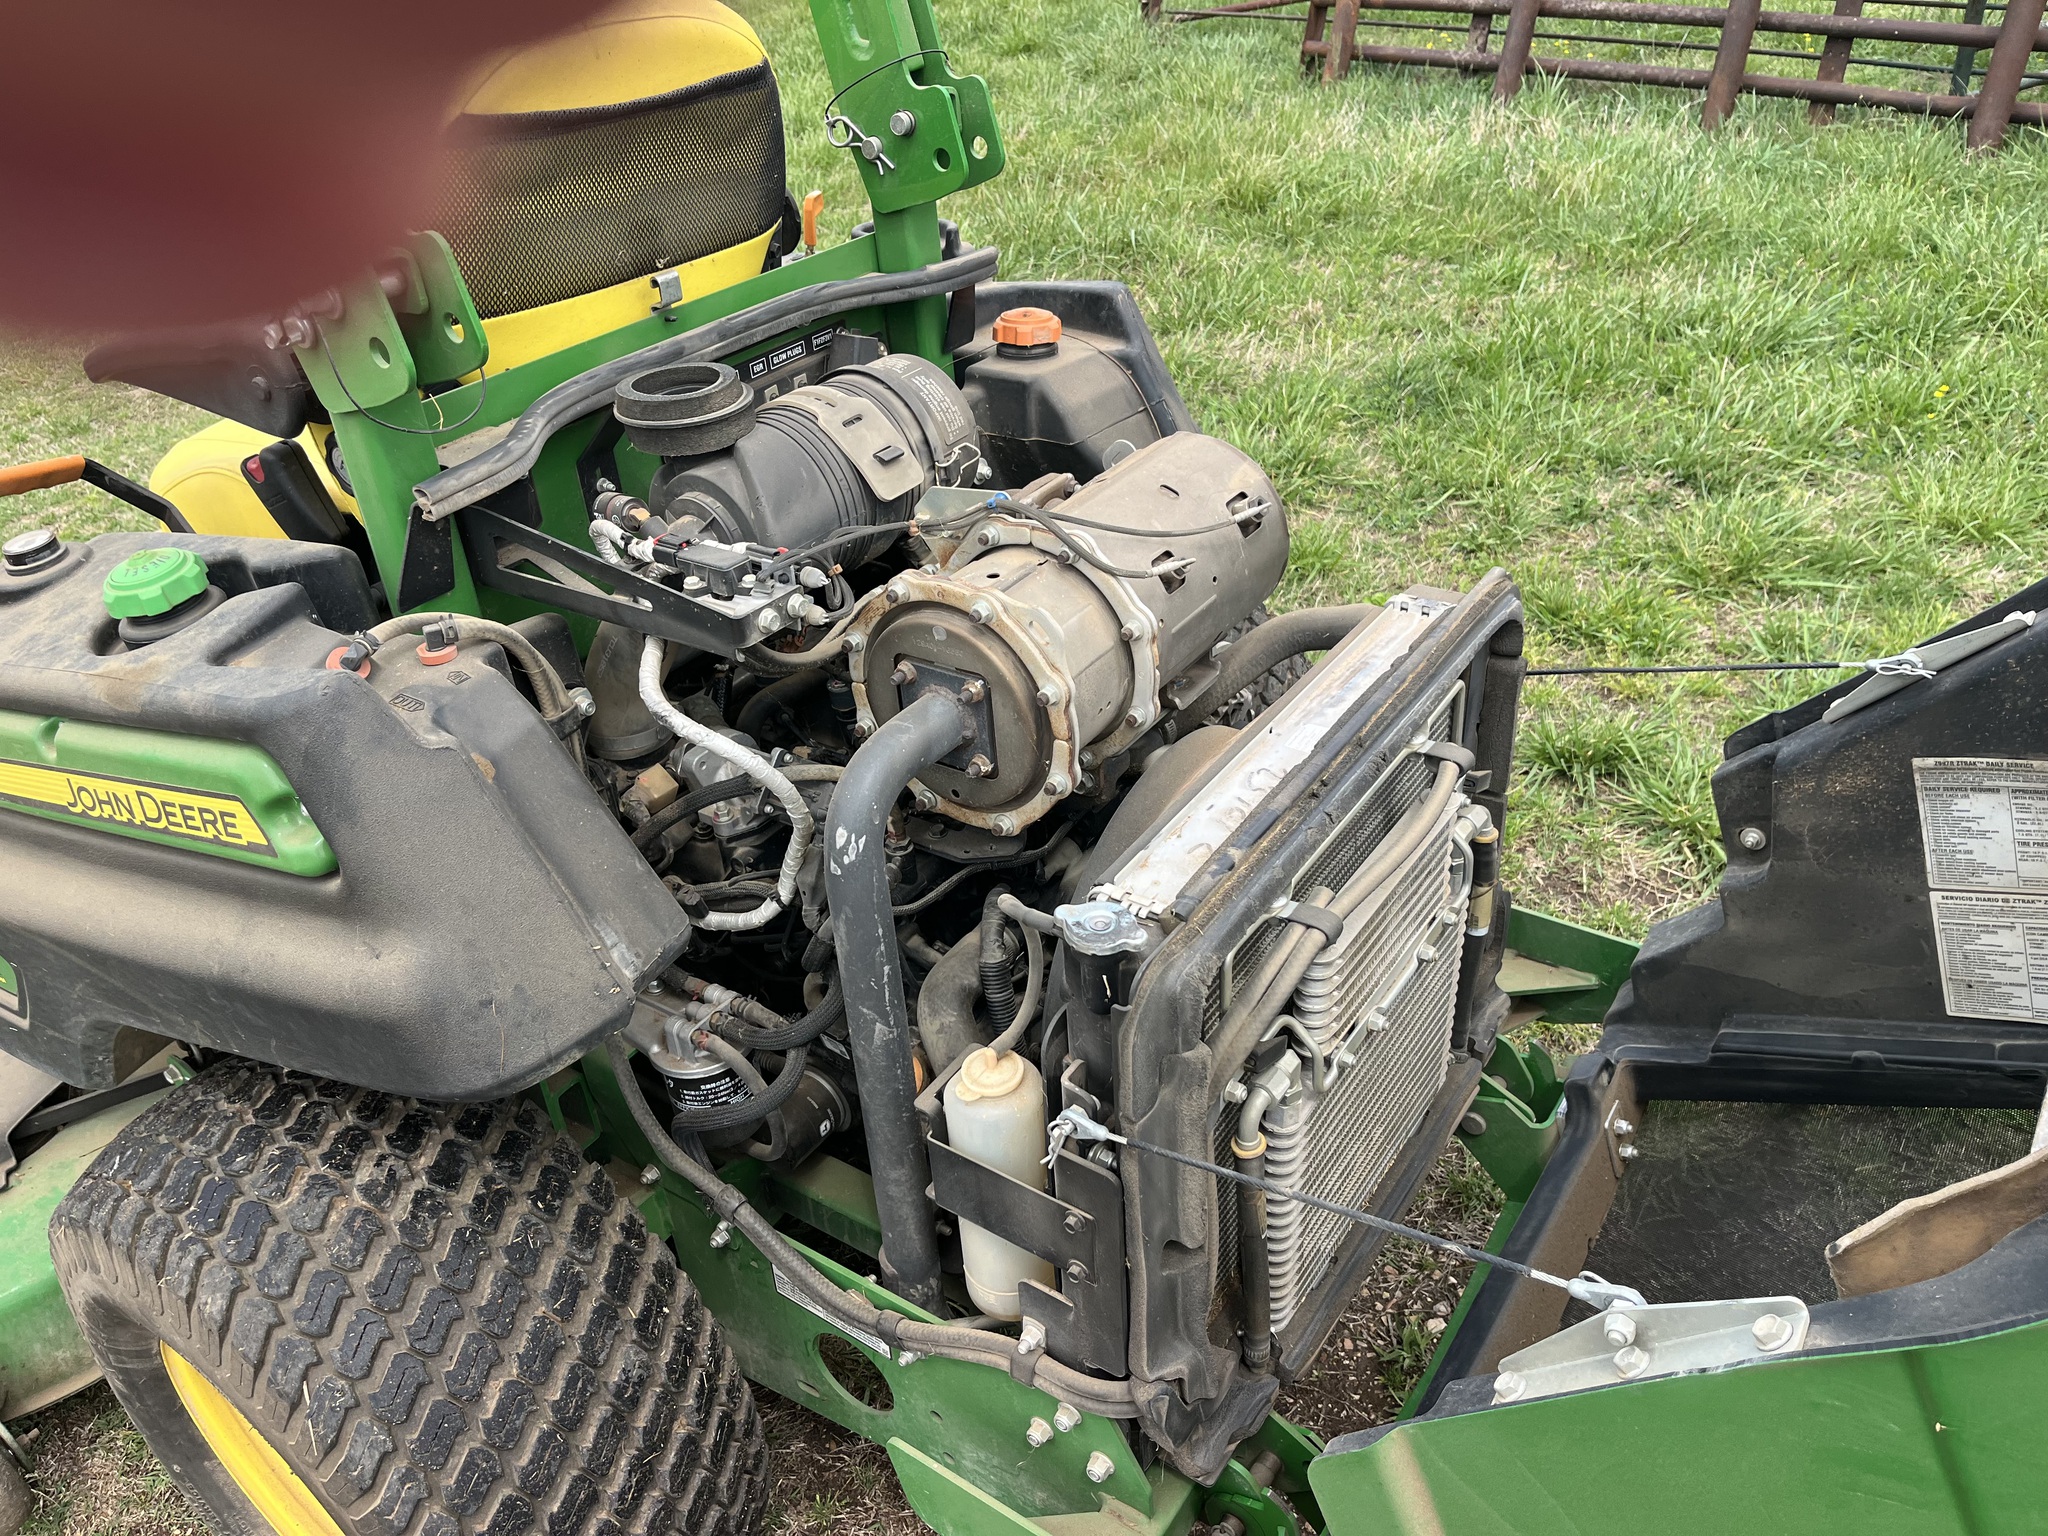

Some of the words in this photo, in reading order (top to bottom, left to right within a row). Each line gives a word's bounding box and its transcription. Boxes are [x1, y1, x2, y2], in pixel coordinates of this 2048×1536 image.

[772, 352, 786, 364] GLOW
[787, 346, 802, 358] PLUGS
[753, 363, 764, 373] EGR
[66, 778, 133, 820] JOHN
[136, 790, 242, 840] DEERE
